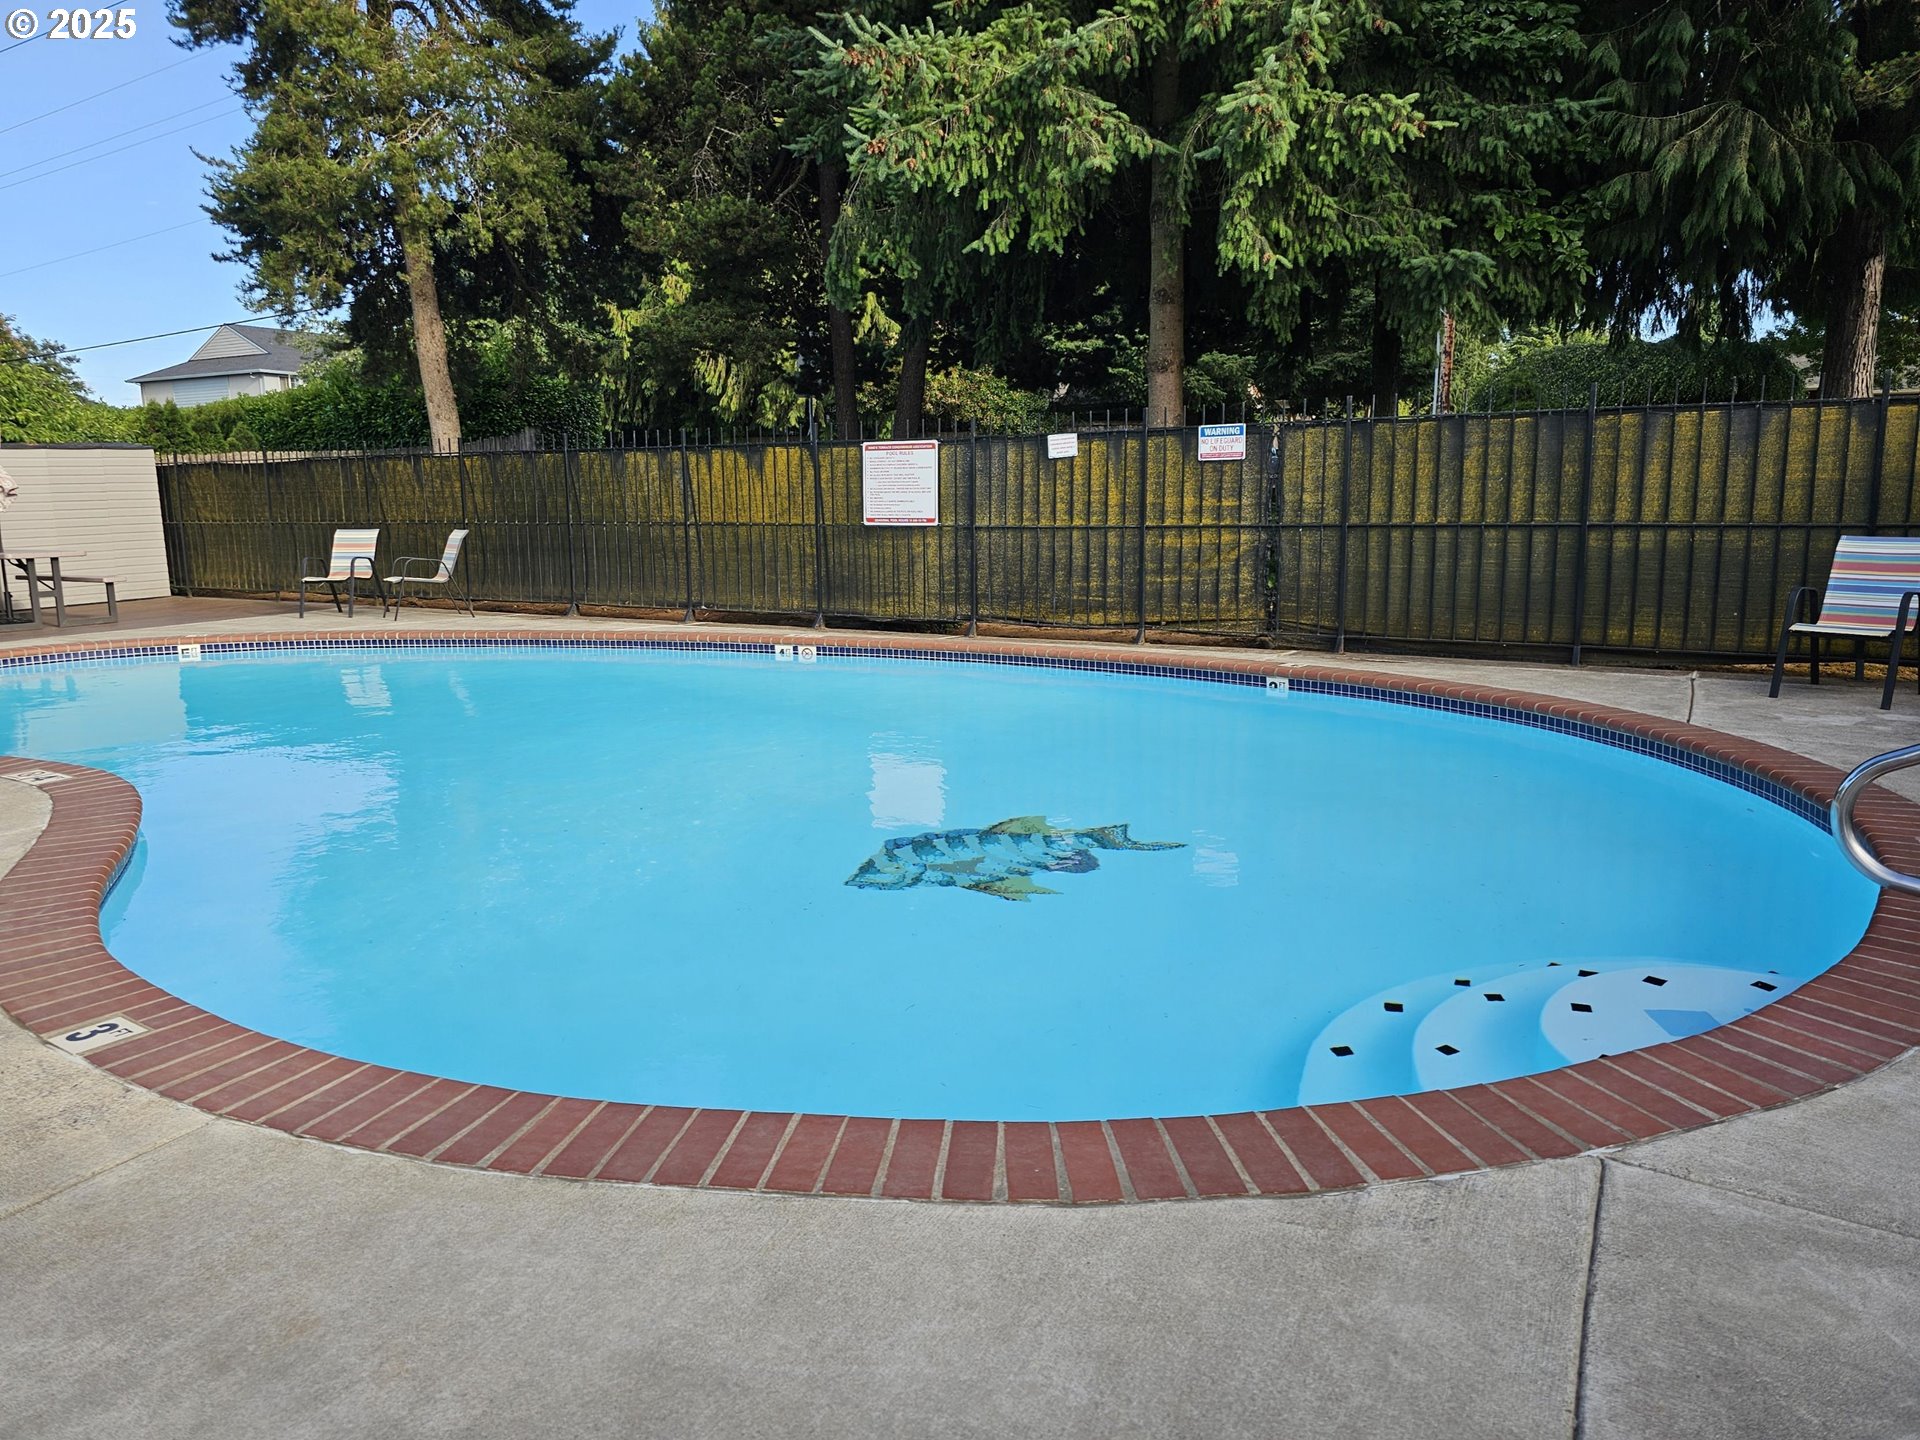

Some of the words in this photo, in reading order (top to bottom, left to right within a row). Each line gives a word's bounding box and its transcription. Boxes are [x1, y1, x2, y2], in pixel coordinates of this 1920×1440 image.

[1203, 426, 1240, 436] WARNING
[1210, 437, 1242, 445] LIFEGUARD
[65, 1023, 119, 1042] 3
[109, 1028, 133, 1037] FT
